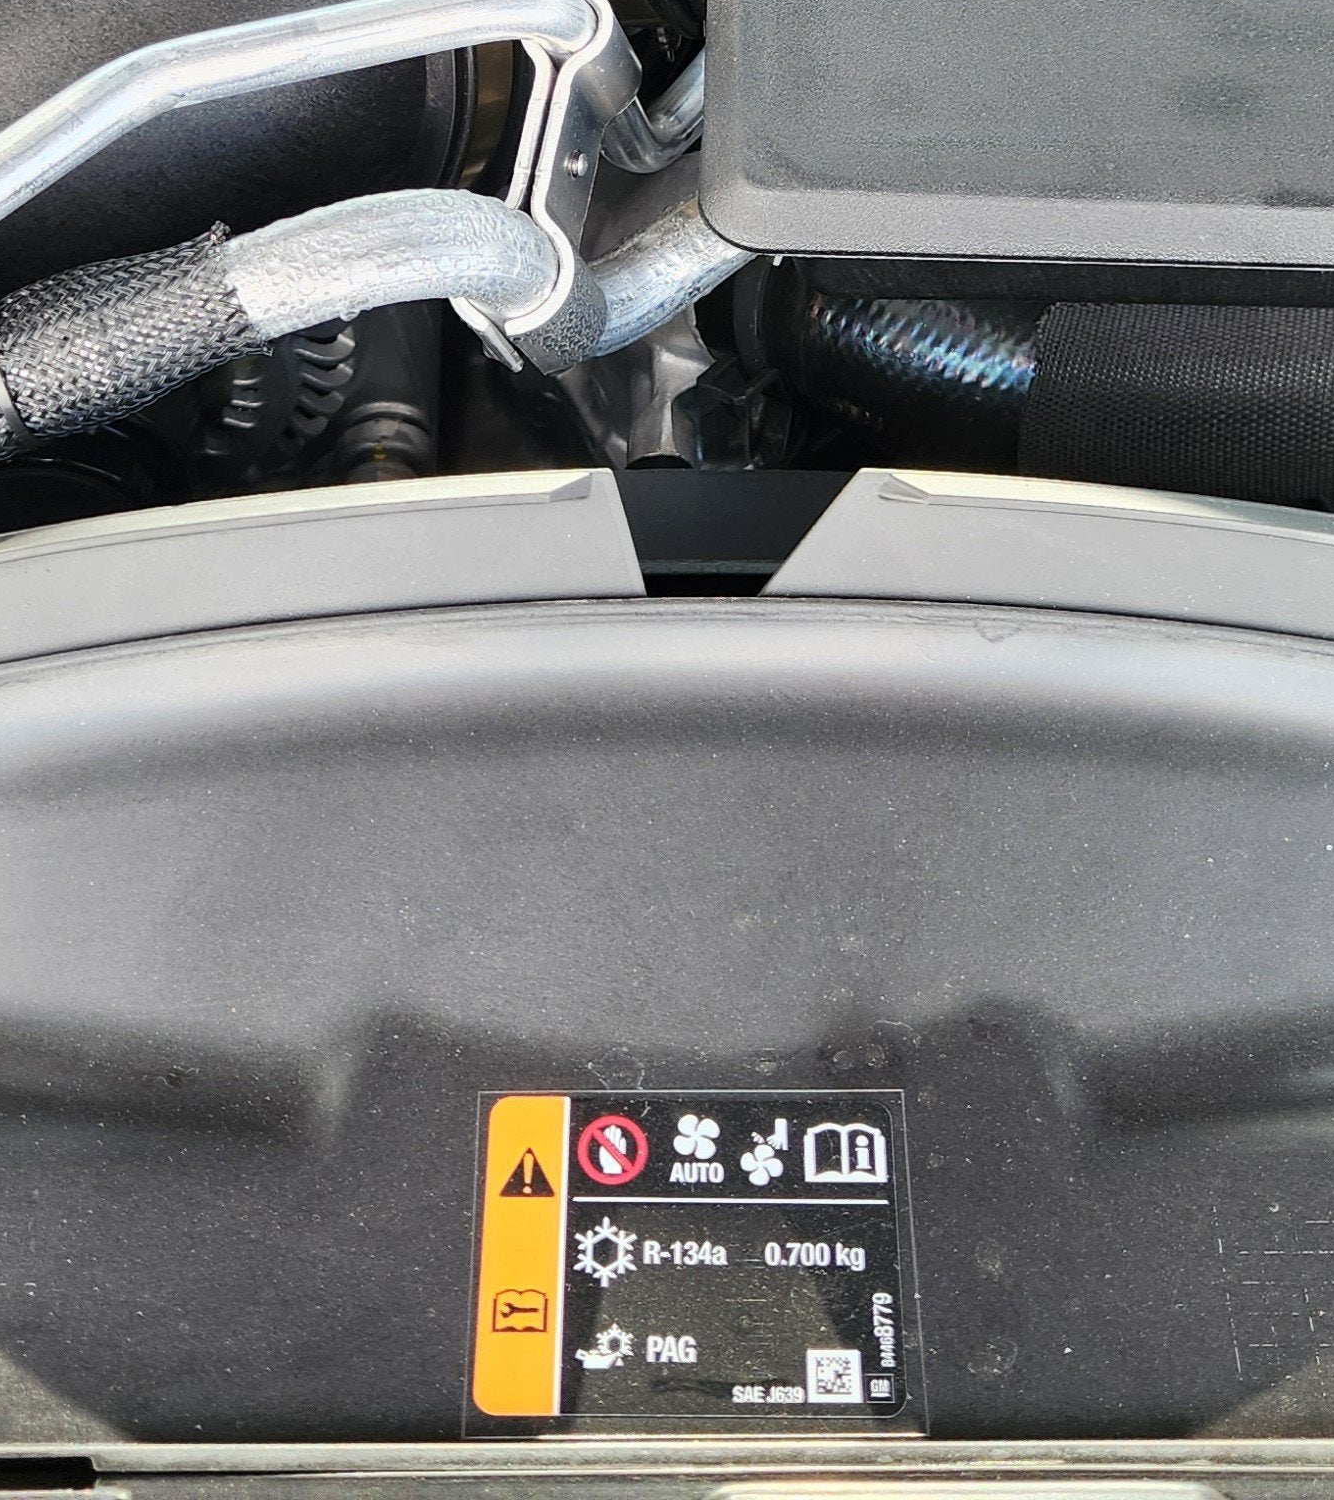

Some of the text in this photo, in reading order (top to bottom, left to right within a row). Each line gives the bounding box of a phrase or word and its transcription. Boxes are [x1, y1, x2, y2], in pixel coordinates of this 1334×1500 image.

[669, 1162, 725, 1184] AUTO
[643, 1240, 866, 1271] R-134a 0.700 kg
[646, 1335, 698, 1363] PAG
[732, 1385, 805, 1404] SAE J639
[870, 1379, 891, 1393] GM
